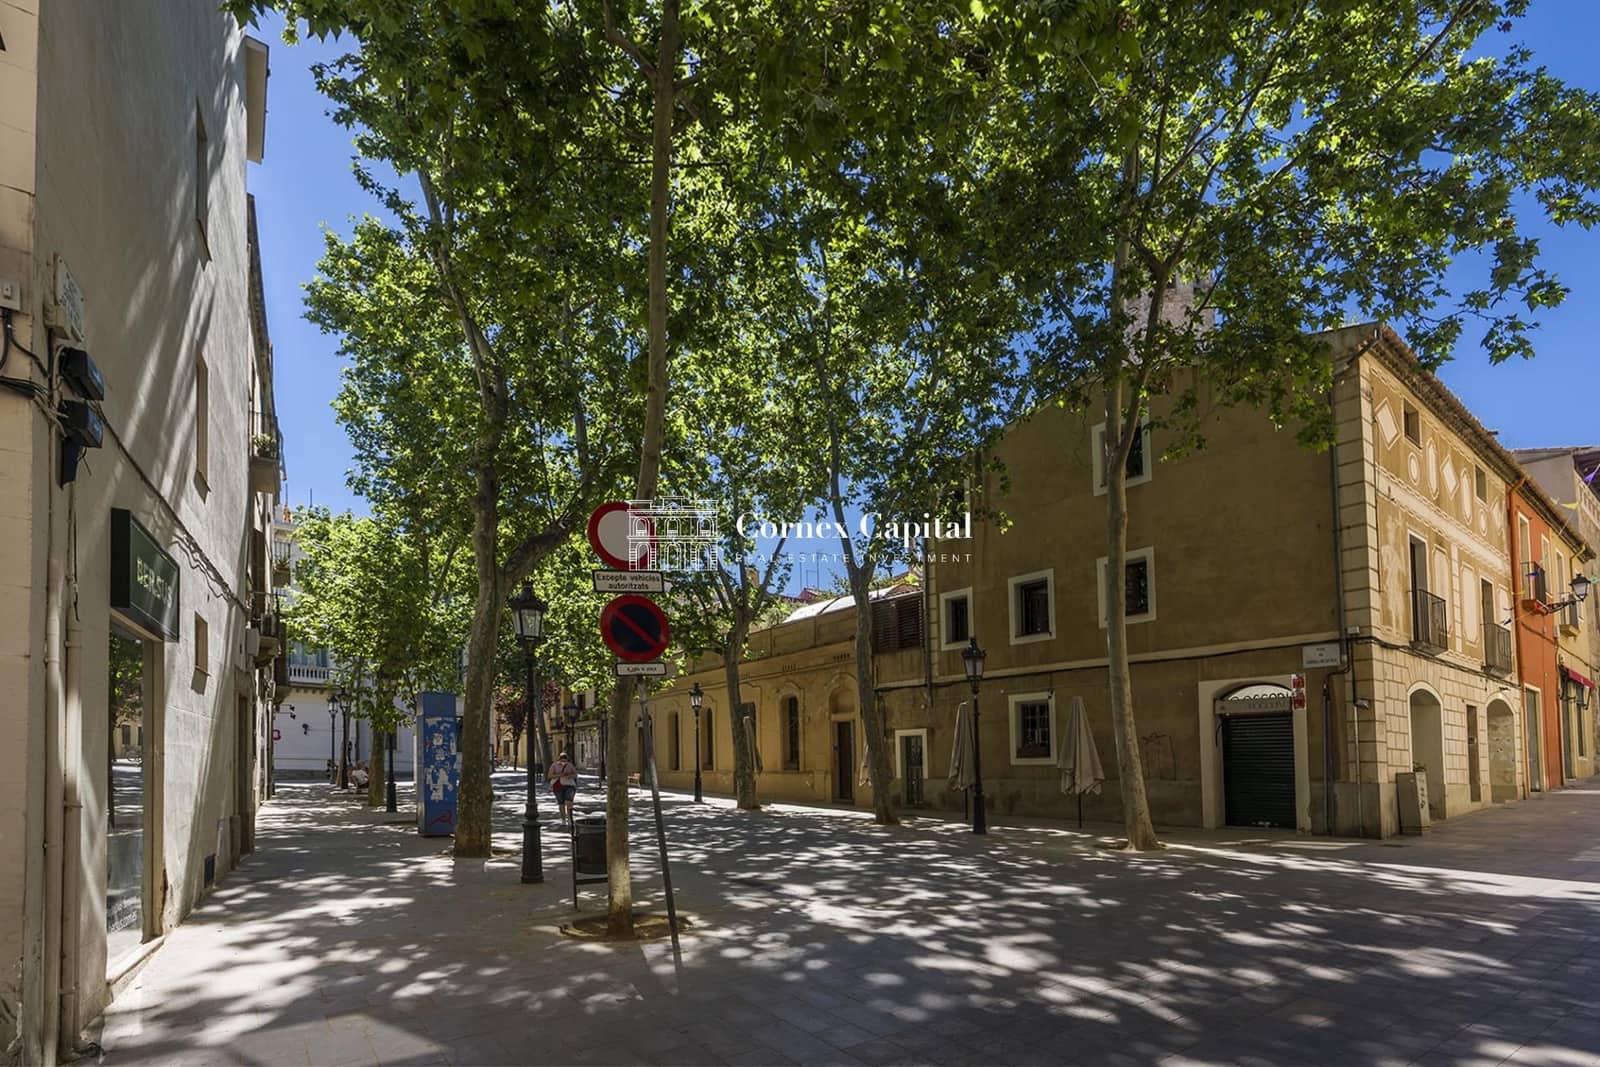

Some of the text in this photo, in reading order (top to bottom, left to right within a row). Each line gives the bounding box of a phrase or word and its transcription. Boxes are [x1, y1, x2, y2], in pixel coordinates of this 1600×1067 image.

[596, 573, 661, 583] Excepte vehicles
[608, 582, 649, 590] autoritzats
